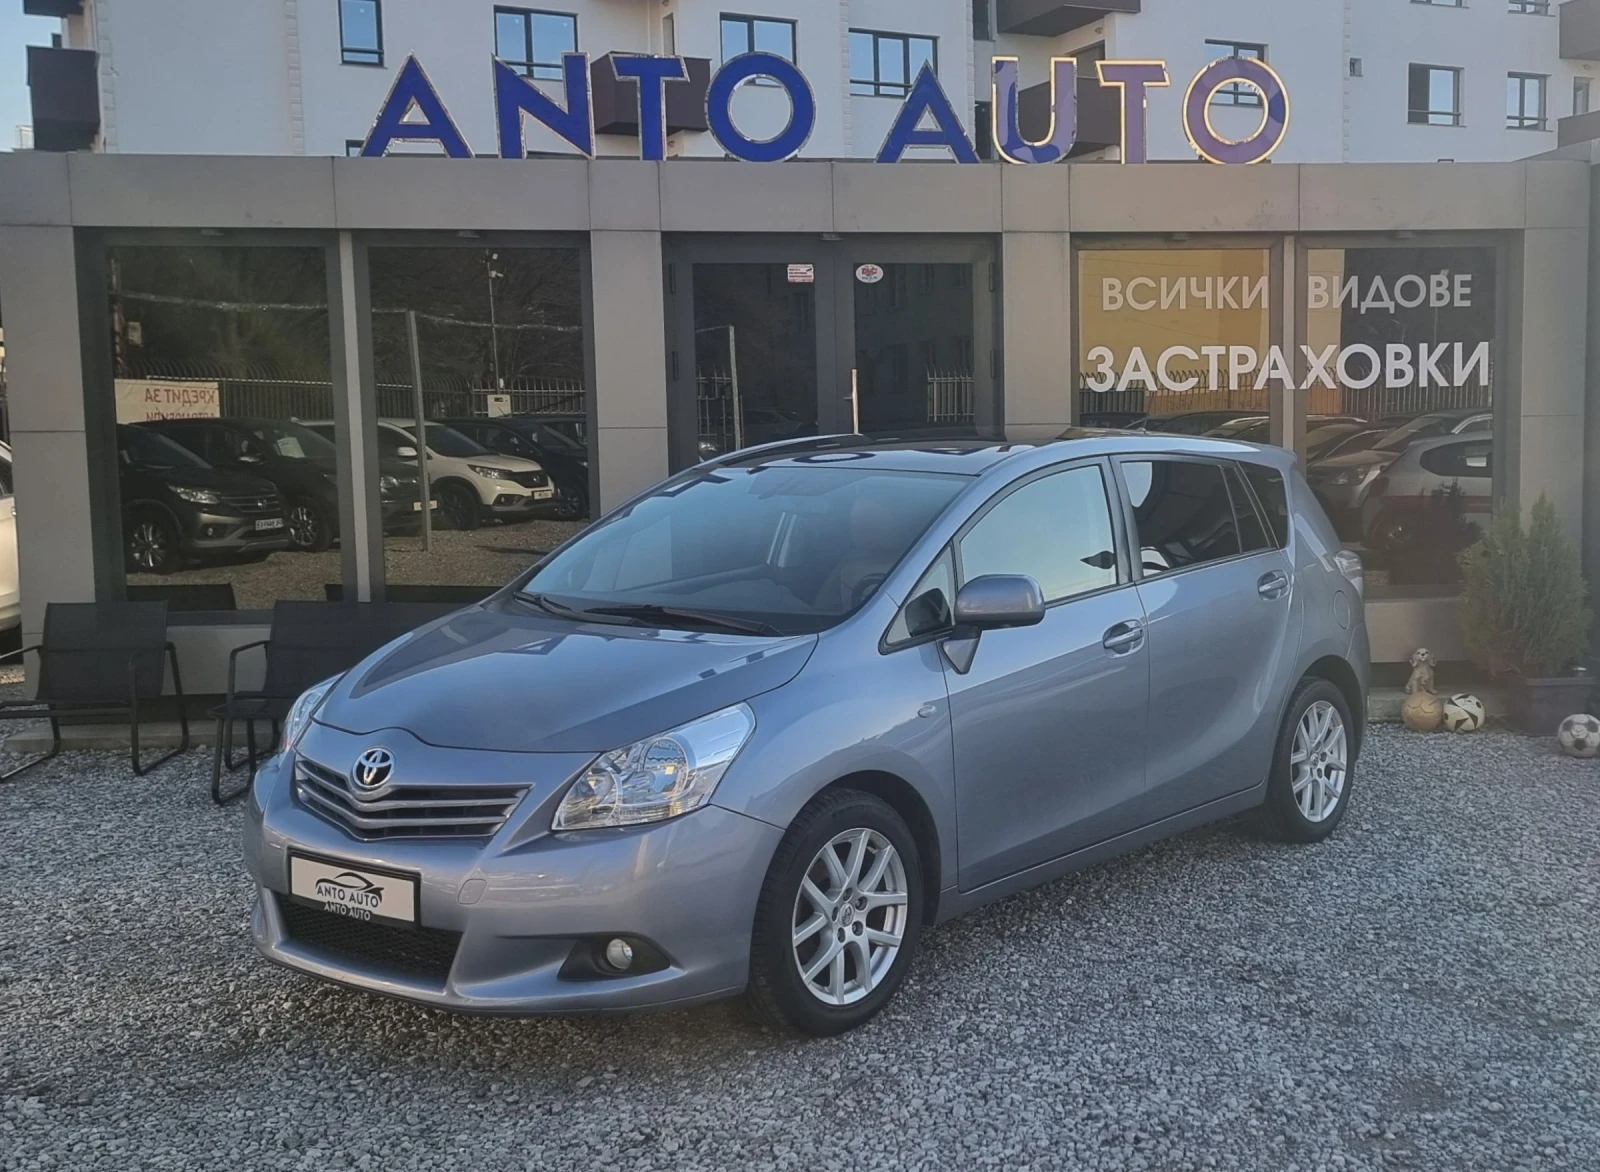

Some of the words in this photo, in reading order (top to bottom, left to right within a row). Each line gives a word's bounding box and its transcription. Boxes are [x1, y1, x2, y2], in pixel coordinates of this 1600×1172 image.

[357, 50, 816, 162] ANTO
[875, 55, 1290, 164] AUTO
[1102, 275, 1269, 311] ВСИЧКИ
[1308, 274, 1472, 315] ВИДОВЕ
[1086, 341, 1490, 392] ЗАСТРАХОВКИ
[316, 885, 345, 900] ANTO
[350, 893, 379, 908] AUTO
[324, 902, 347, 915] ANTO
[349, 908, 371, 921] AUTO
